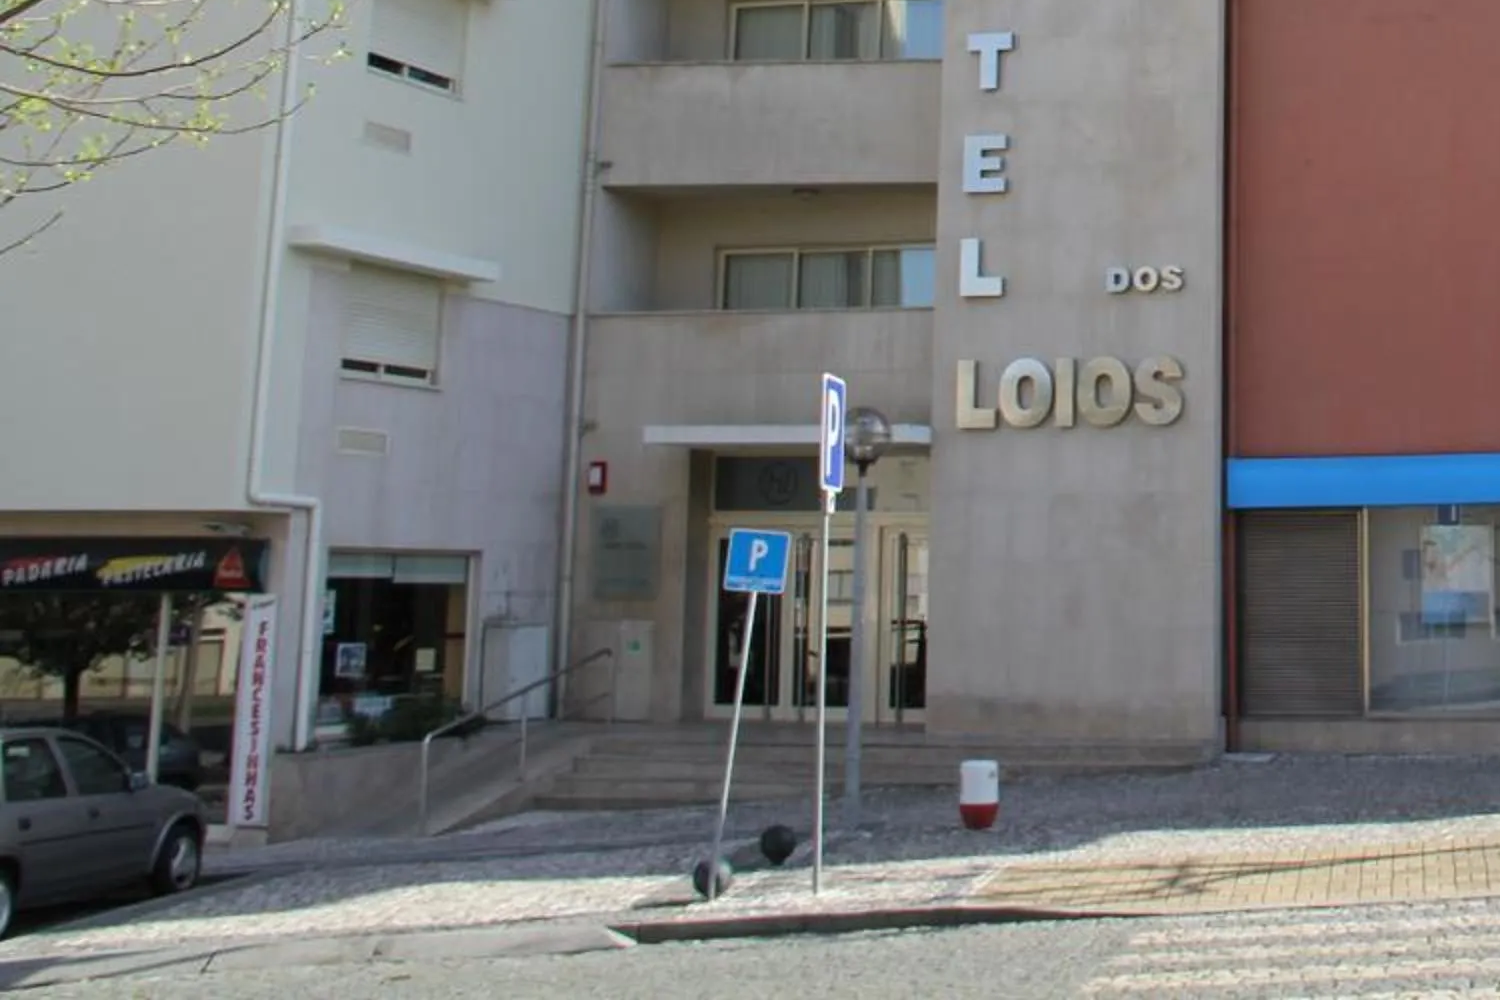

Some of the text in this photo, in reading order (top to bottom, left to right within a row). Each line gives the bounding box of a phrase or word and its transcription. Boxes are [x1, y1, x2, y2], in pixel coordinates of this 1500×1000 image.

[1105, 264, 1184, 293] DOS
[956, 356, 1184, 430] LOIOS
[825, 388, 840, 478] P
[1, 553, 89, 587] PADARIA
[748, 539, 769, 573] P
[243, 620, 269, 821] FRANCESINHAS
